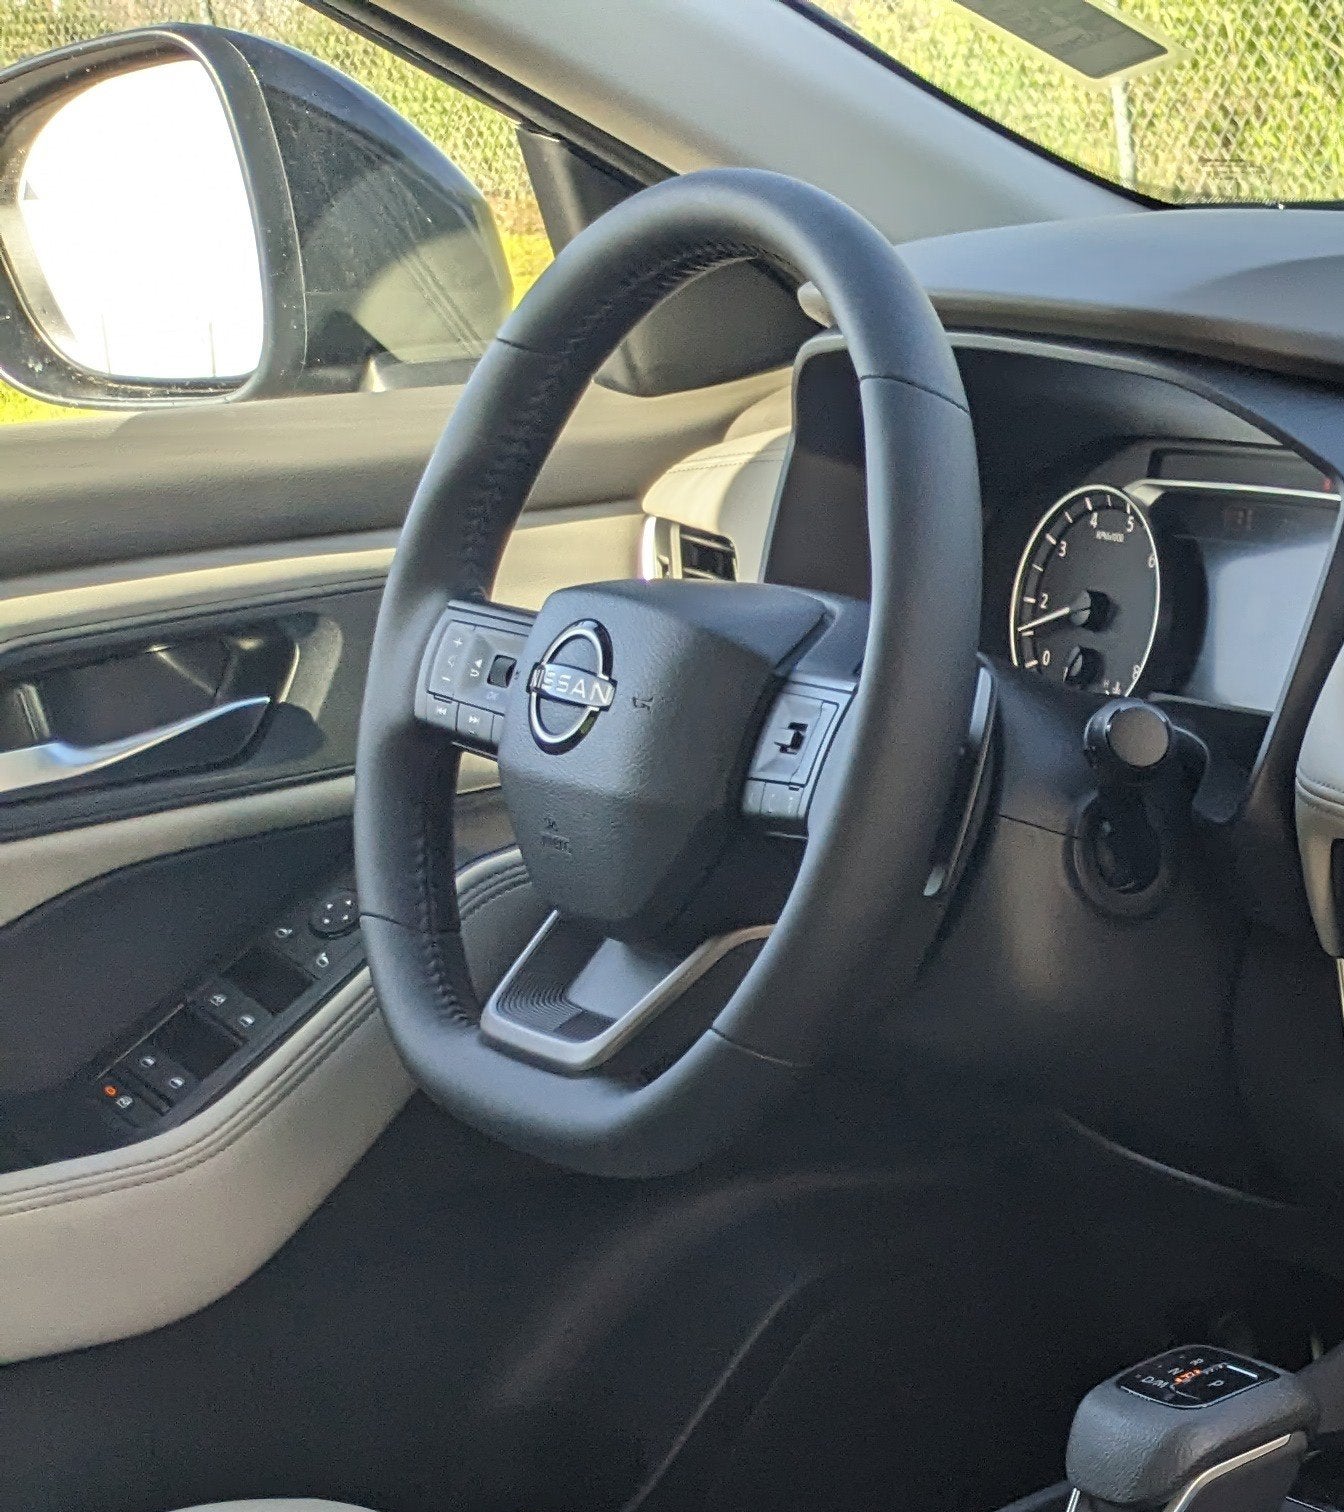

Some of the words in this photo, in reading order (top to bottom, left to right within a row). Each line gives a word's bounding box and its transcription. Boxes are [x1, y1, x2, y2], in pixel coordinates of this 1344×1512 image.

[1090, 512, 1098, 528] 4
[1126, 515, 1135, 533] 5
[1058, 540, 1067, 557] 3
[1040, 593, 1049, 610] 2
[1042, 650, 1051, 666] 0
